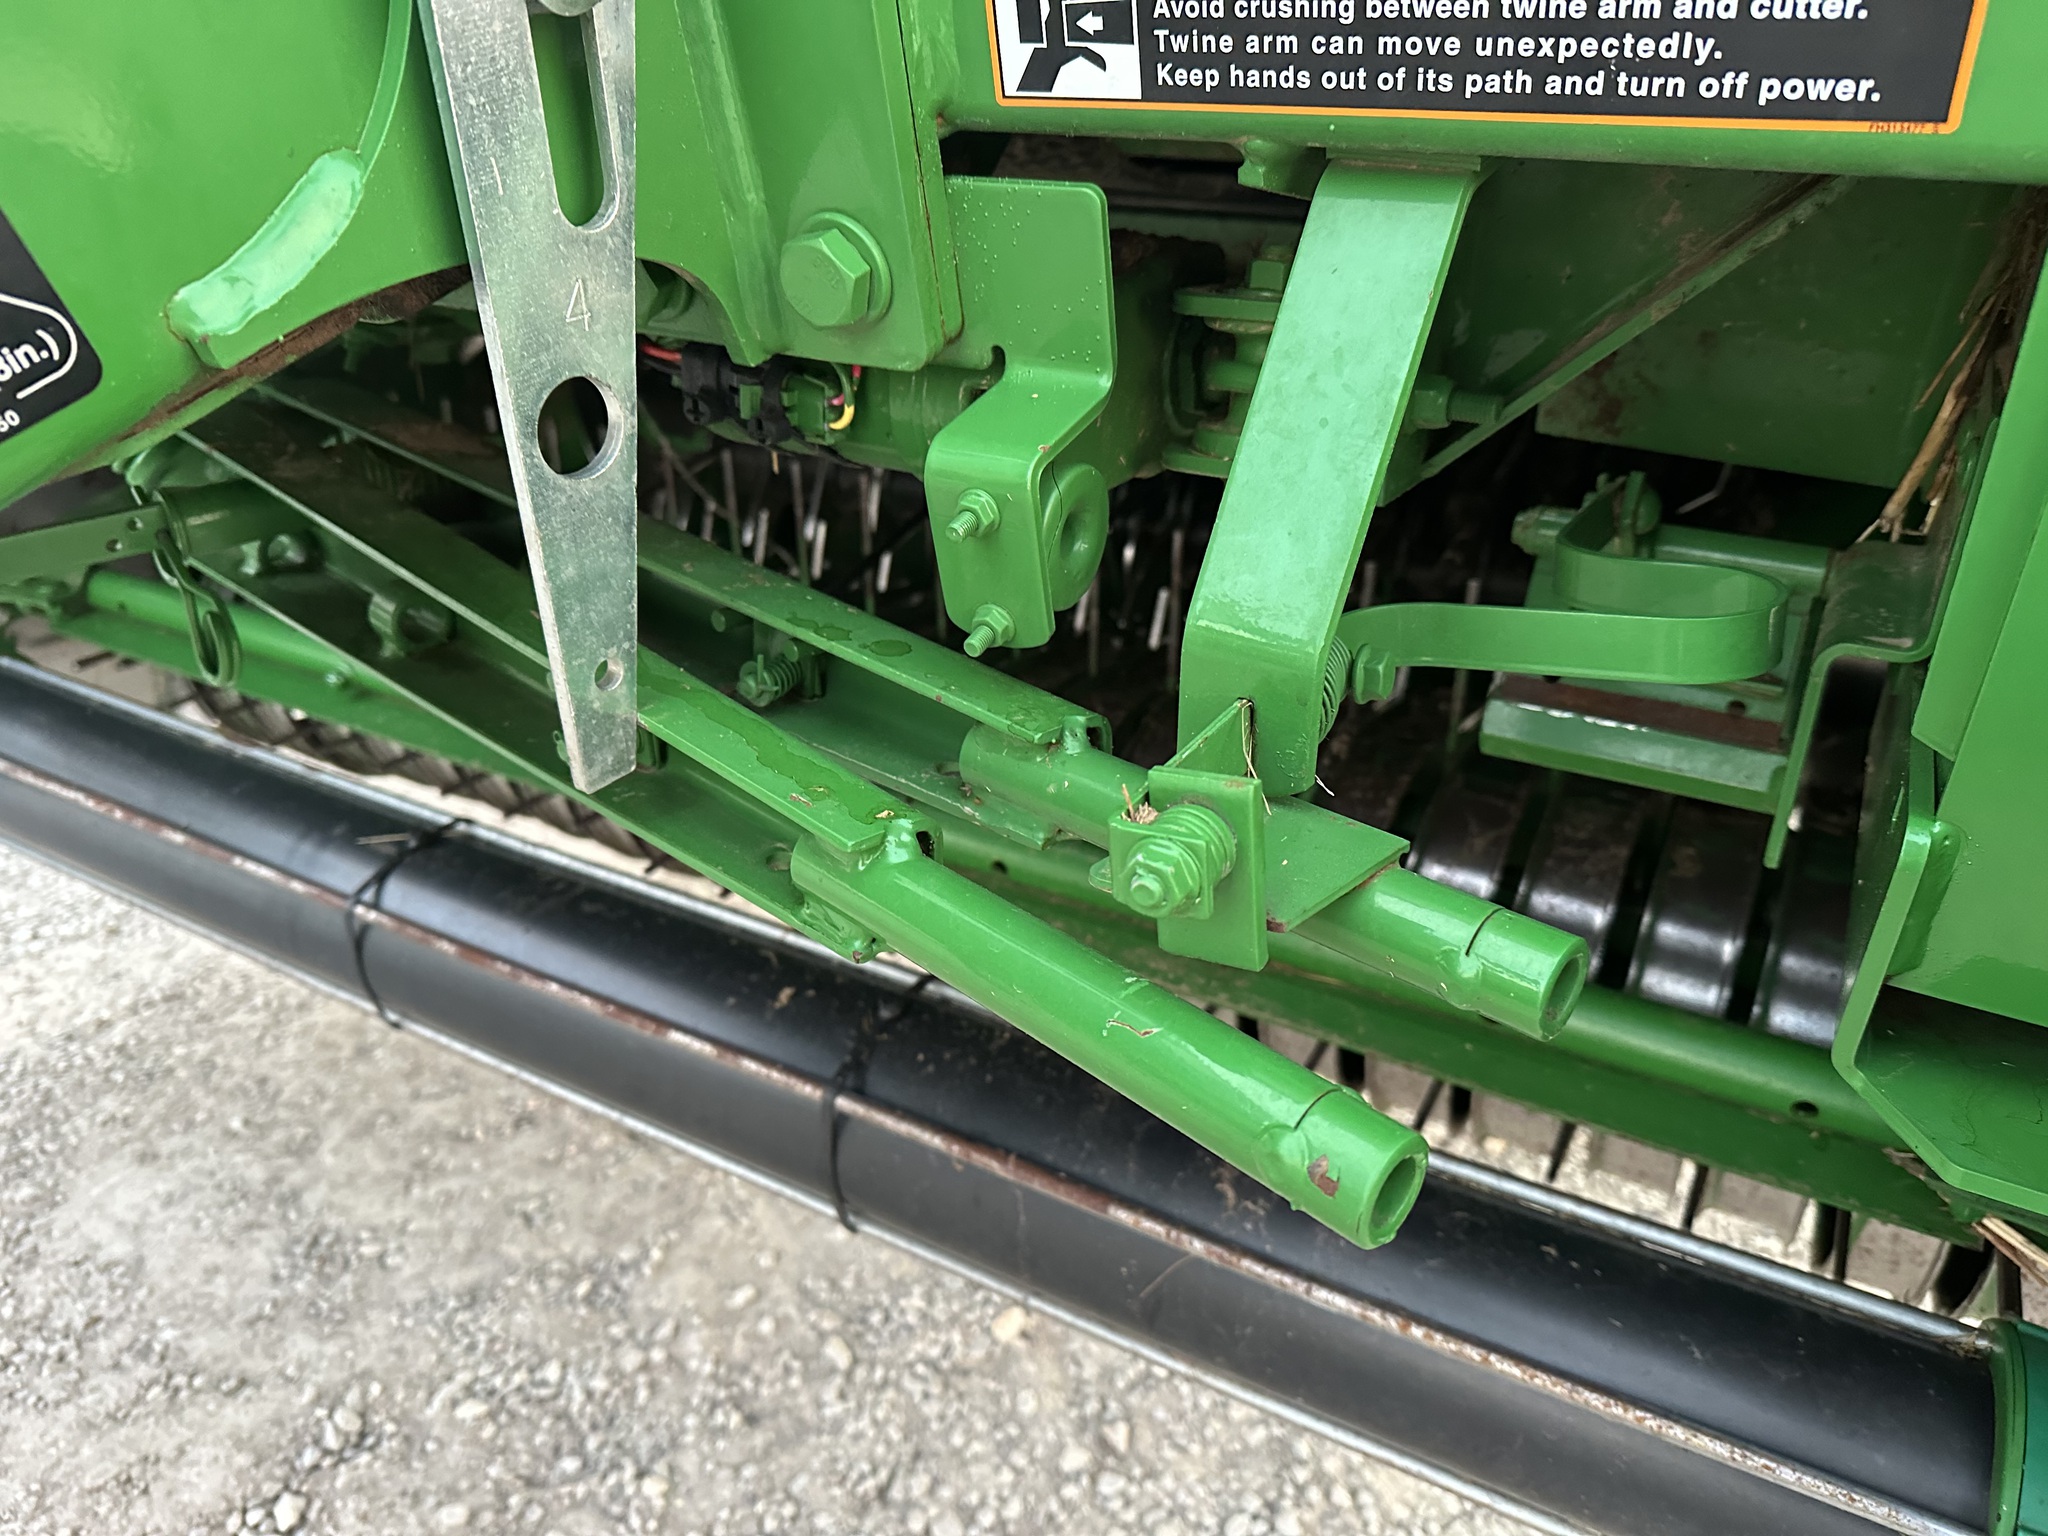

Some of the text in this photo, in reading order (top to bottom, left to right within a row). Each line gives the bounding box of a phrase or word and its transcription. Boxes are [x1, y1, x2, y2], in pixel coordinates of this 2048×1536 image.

[1153, 0, 1869, 25] Avoid crushing between twine arm and cutter.
[1153, 28, 1723, 66] Twine arm can move unexpectedly.
[1156, 62, 1881, 106] Keep hands out of its path and turn off power.
[564, 278, 592, 332] 4
